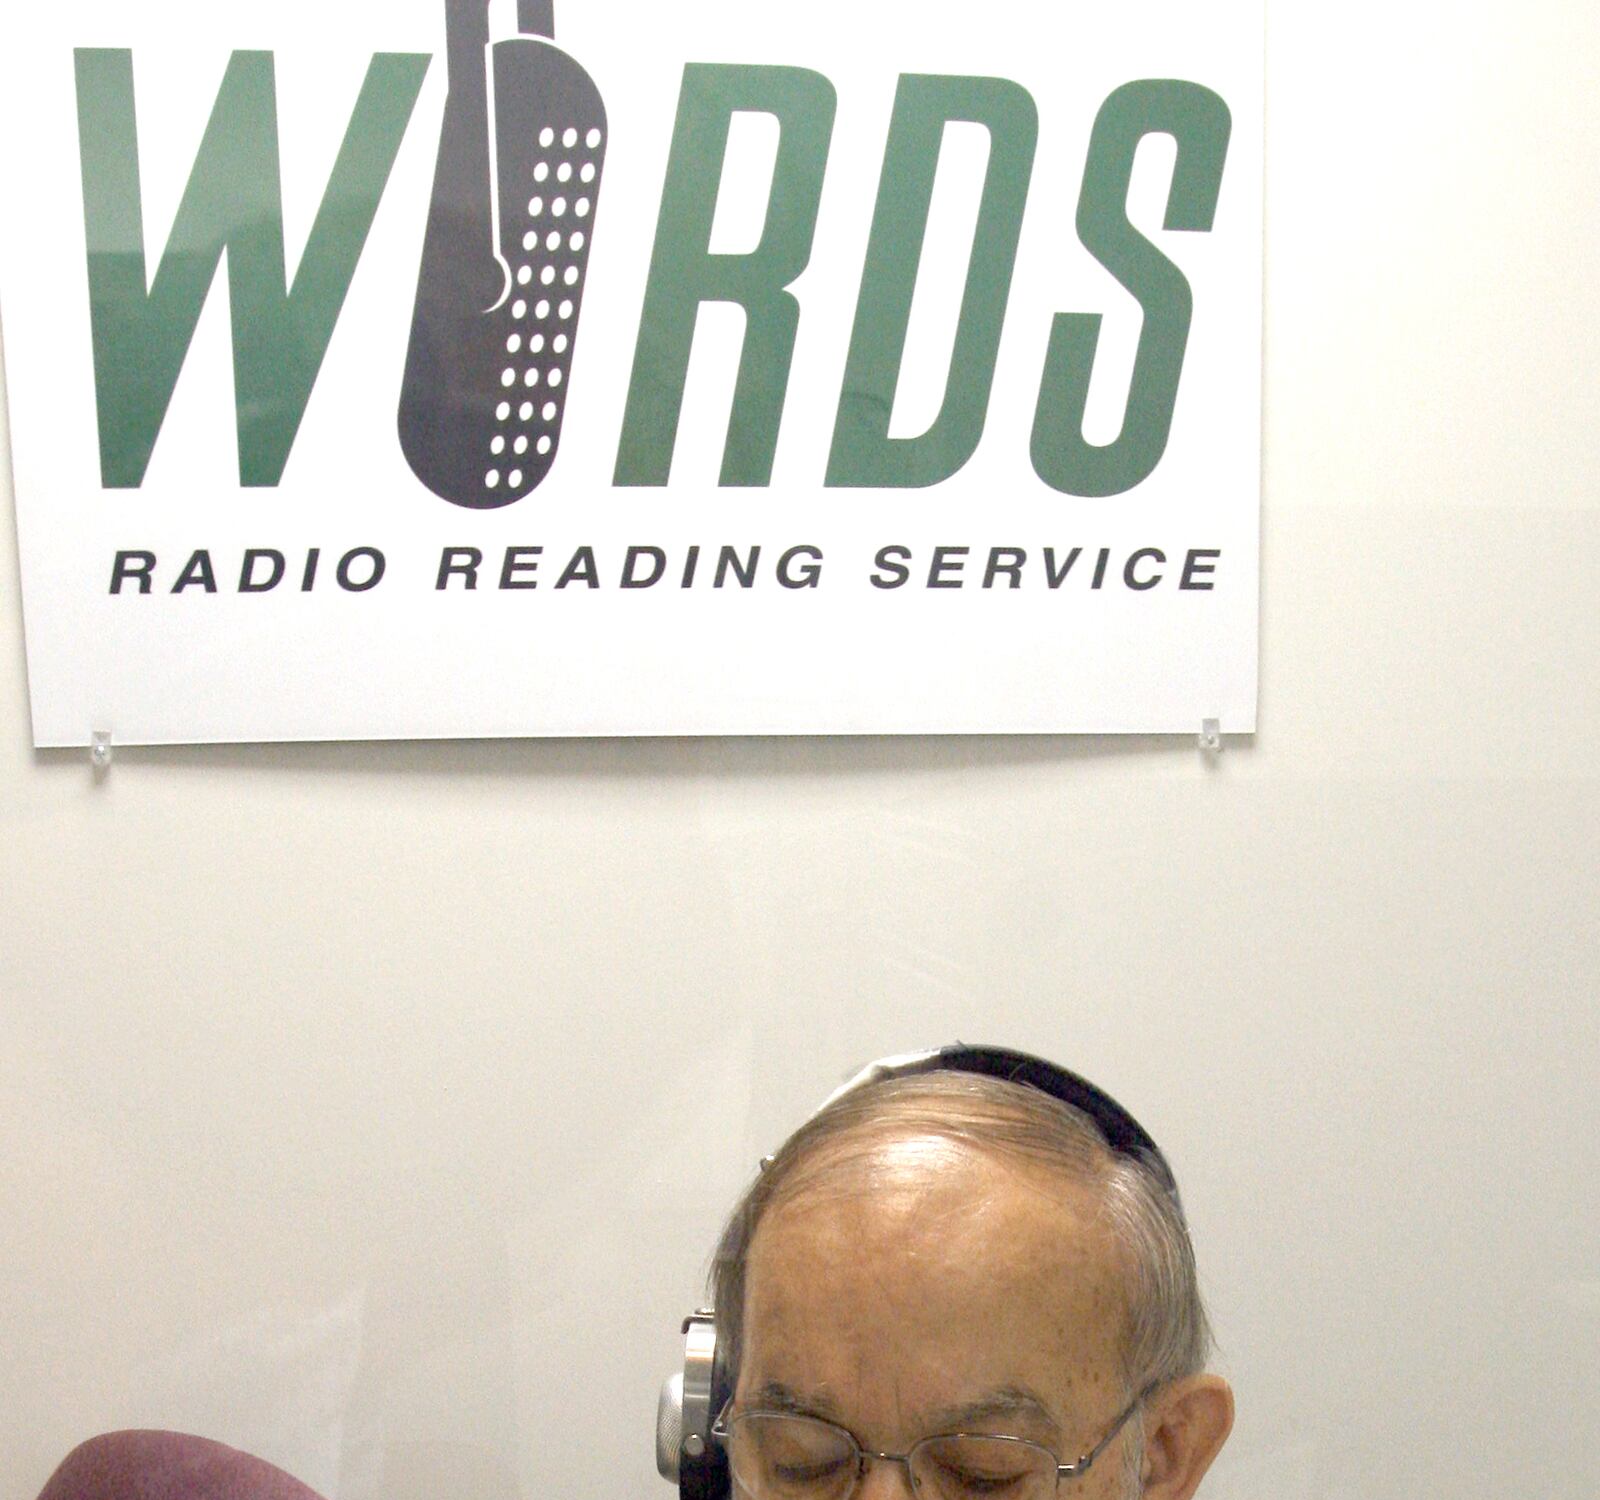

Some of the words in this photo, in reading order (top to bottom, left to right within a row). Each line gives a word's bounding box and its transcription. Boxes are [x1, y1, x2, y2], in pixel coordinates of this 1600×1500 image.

[109, 549, 388, 595] RADIO
[435, 545, 825, 591] READING
[869, 544, 1222, 592] SERVICE
